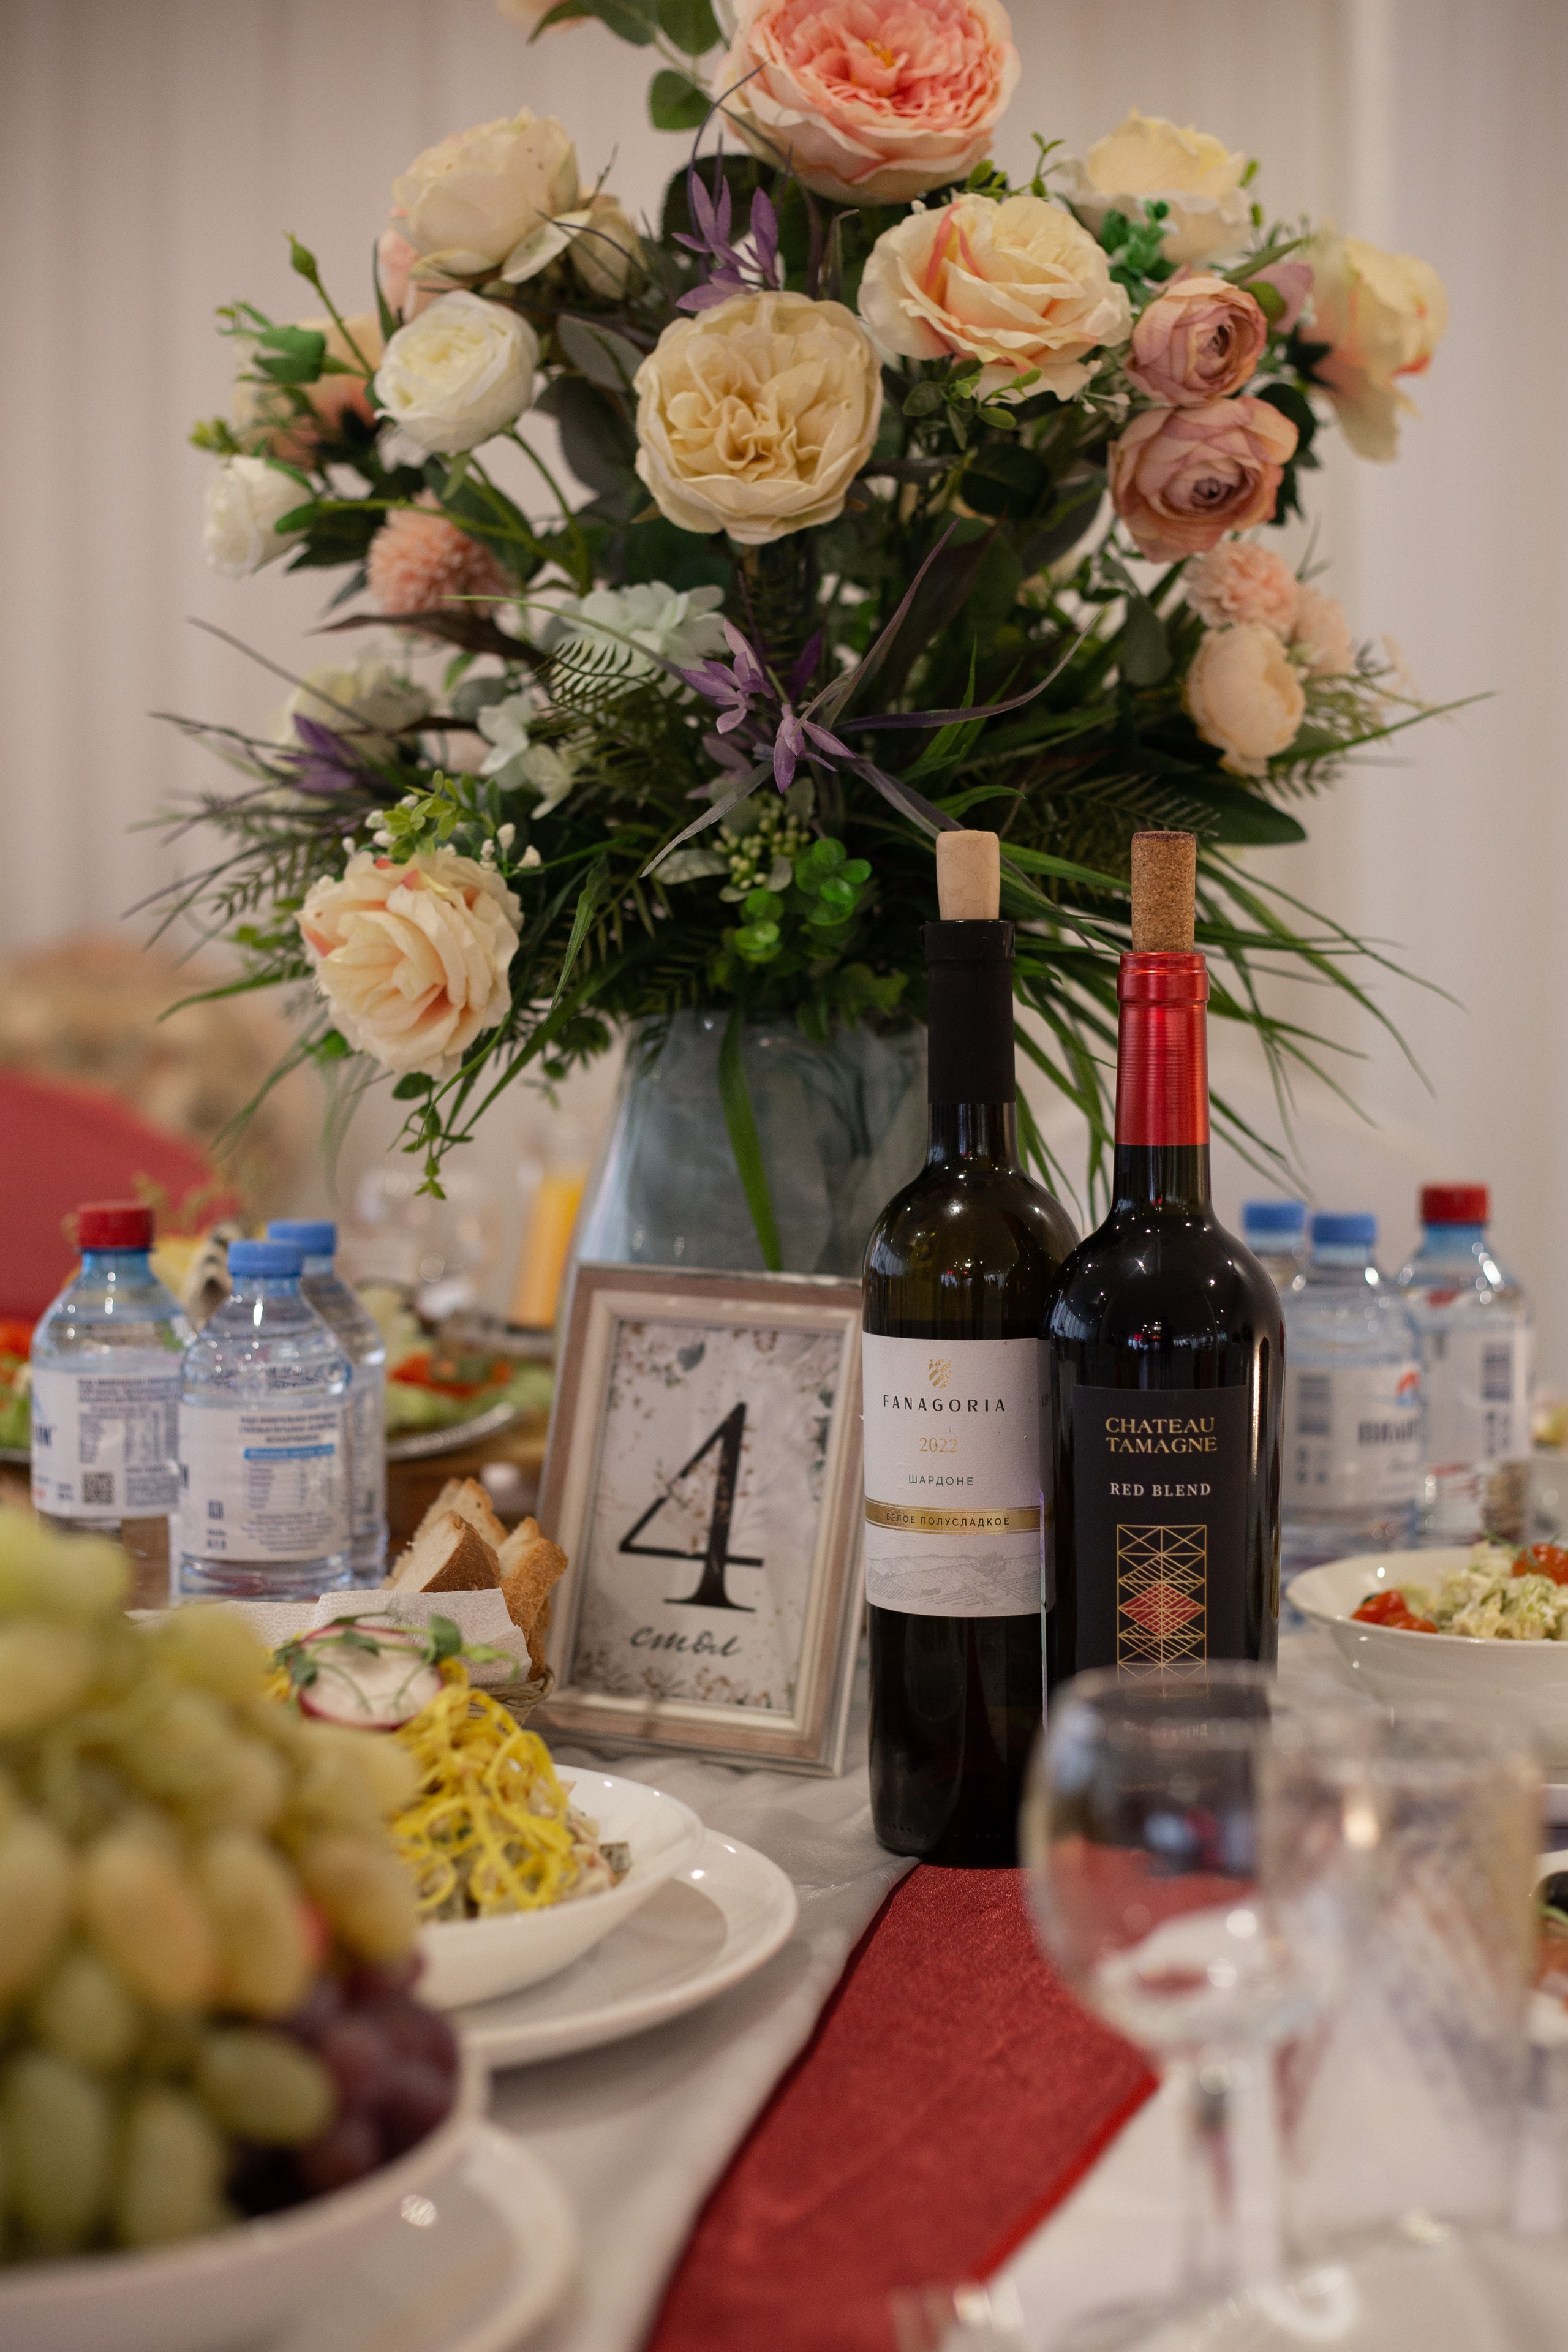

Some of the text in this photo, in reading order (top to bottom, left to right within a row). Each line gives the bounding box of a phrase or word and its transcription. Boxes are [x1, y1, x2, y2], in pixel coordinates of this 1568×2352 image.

[883, 1395, 1005, 1412] FANAGORIA
[1106, 1417, 1215, 1434] CHATEAU
[919, 1438, 959, 1453] 2022
[1106, 1436, 1217, 1453] TAMAGNE
[908, 1474, 974, 1487] ШАРДОНЕ
[1110, 1482, 1211, 1497] RED BLEND
[619, 1400, 763, 1612] 4
[886, 1513, 1009, 1528] БЕЛОЕ ПОЛУСЛАДКОЕ
